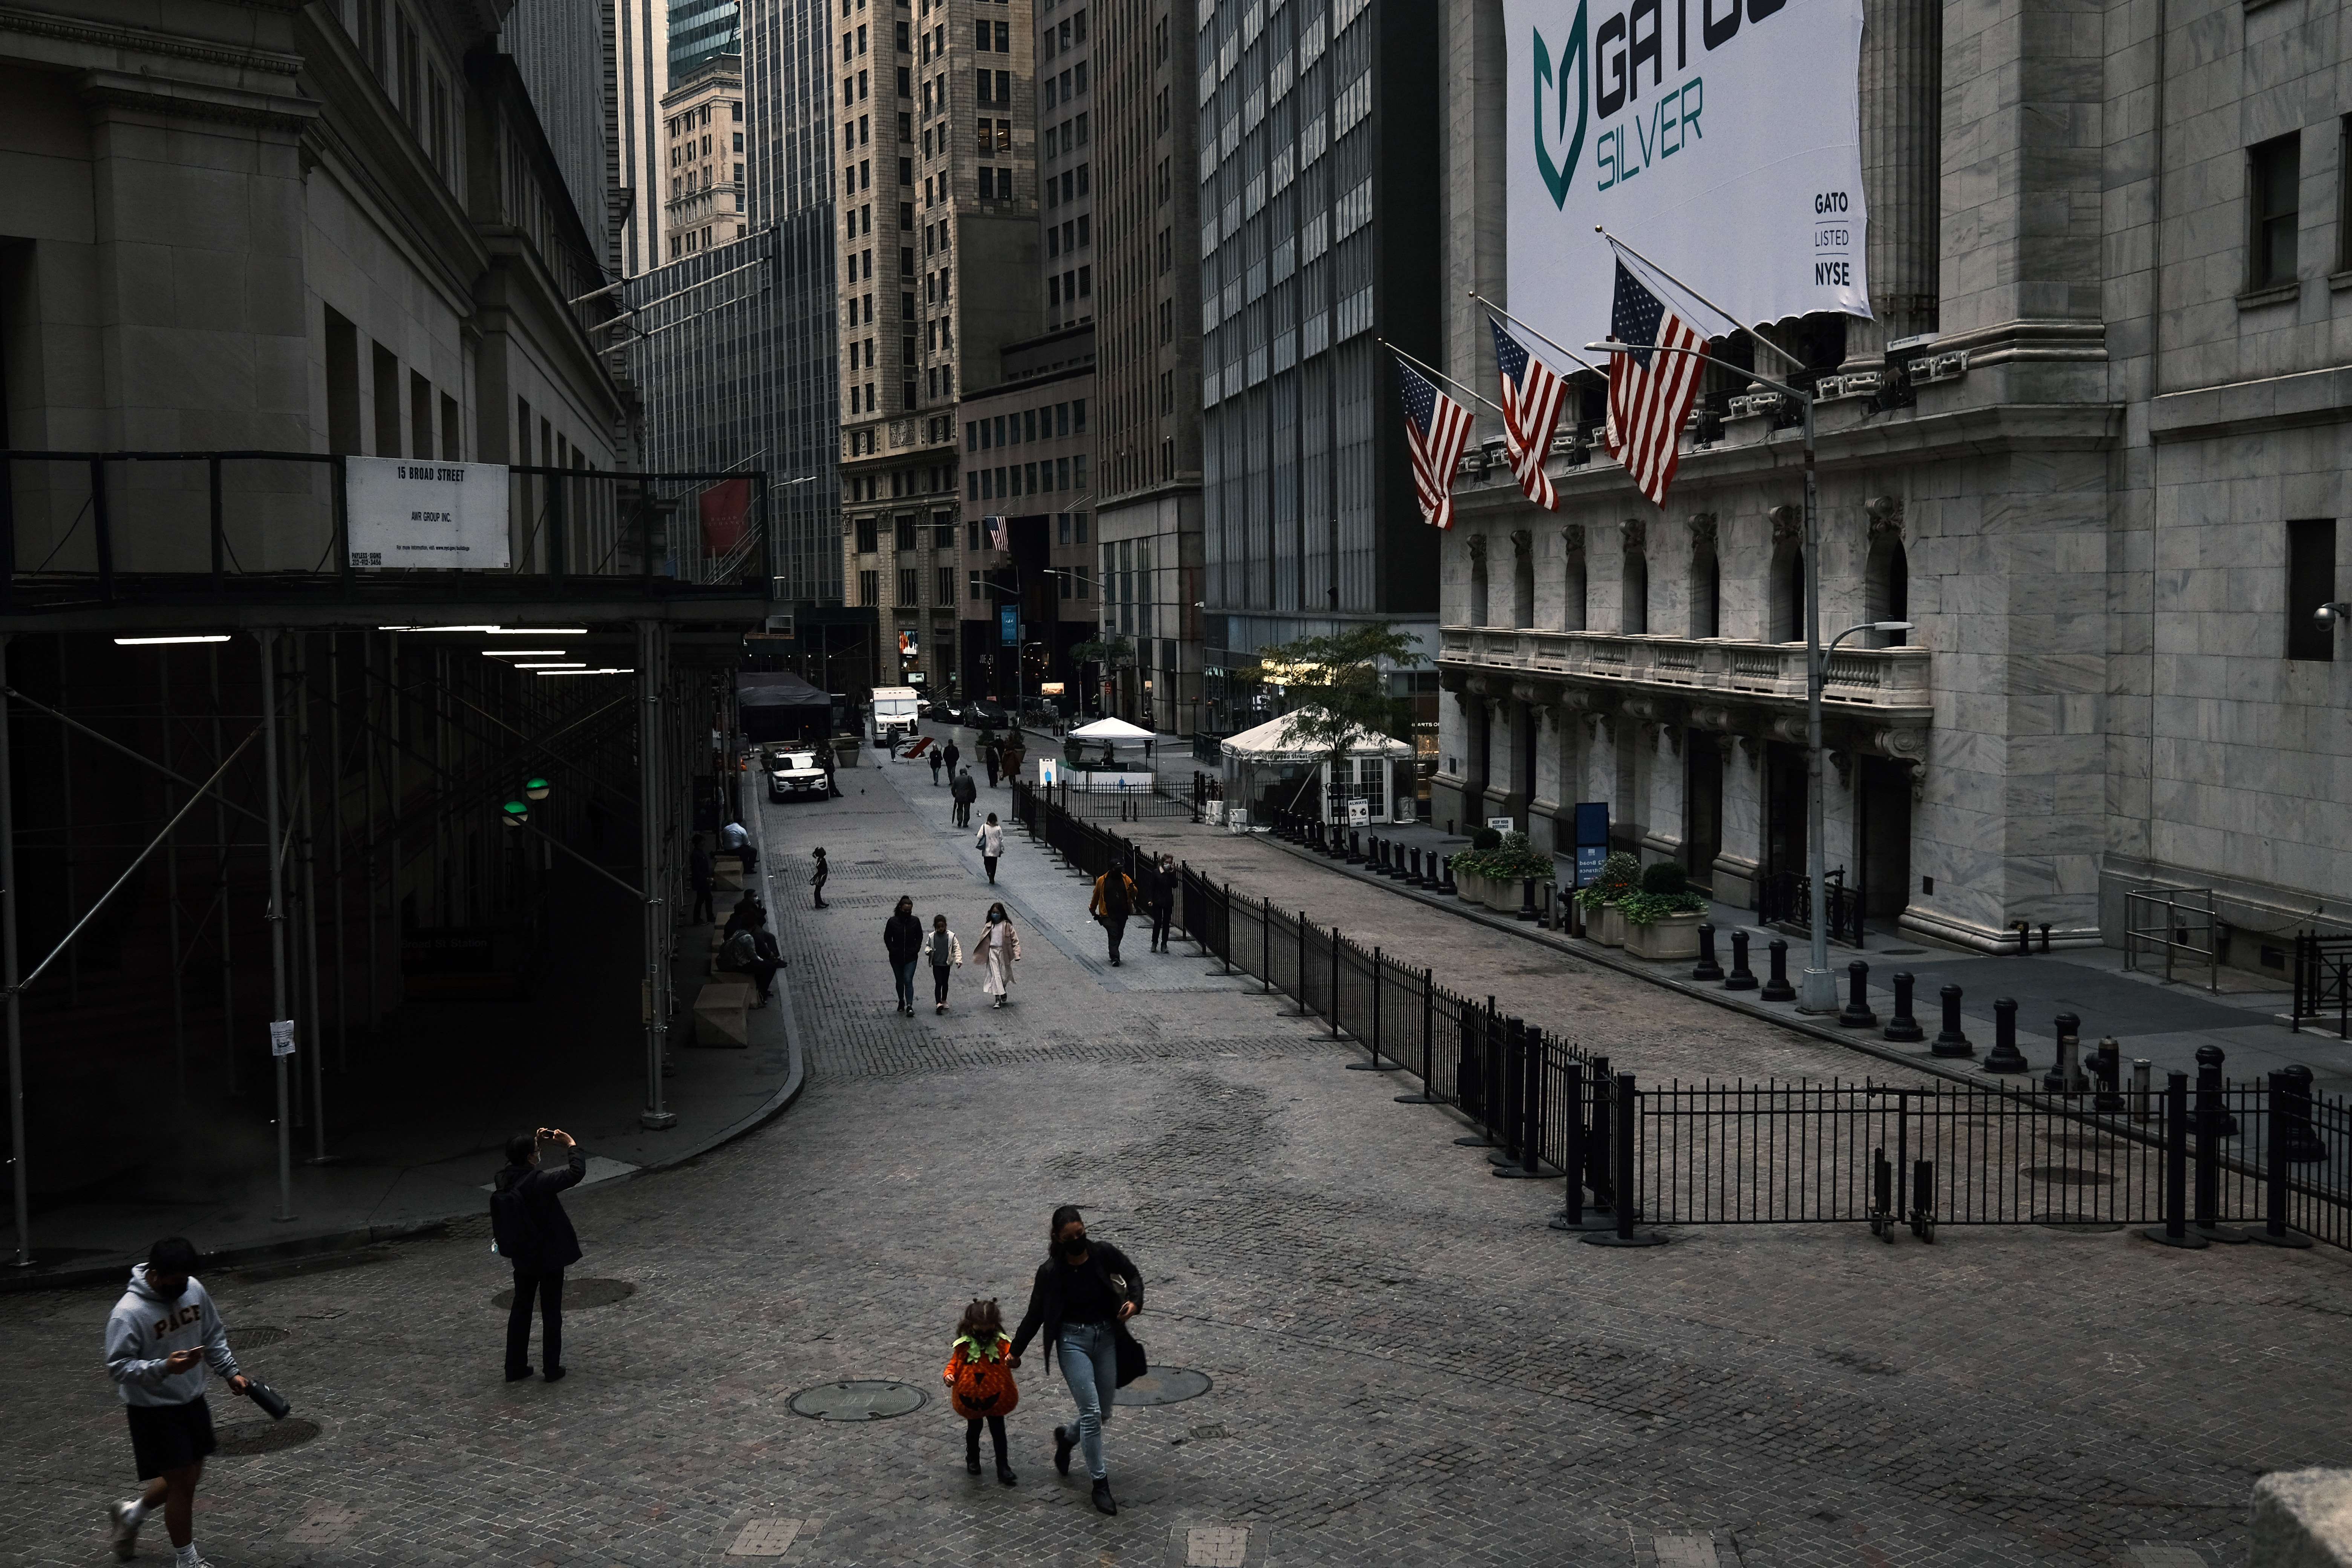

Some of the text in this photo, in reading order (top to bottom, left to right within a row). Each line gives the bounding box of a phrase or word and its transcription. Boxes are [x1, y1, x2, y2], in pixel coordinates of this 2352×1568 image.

[1597, 77, 1703, 191] SILVER
[1815, 192, 1848, 214] GATO
[1815, 230, 1849, 247] LISTED
[1816, 262, 1850, 286] NYSE
[398, 466, 464, 482] 15 BROAD STREET
[411, 511, 452, 522] AWR GROUP INC.
[400, 937, 488, 948] Broad St Station
[153, 1305, 200, 1340] PACE
